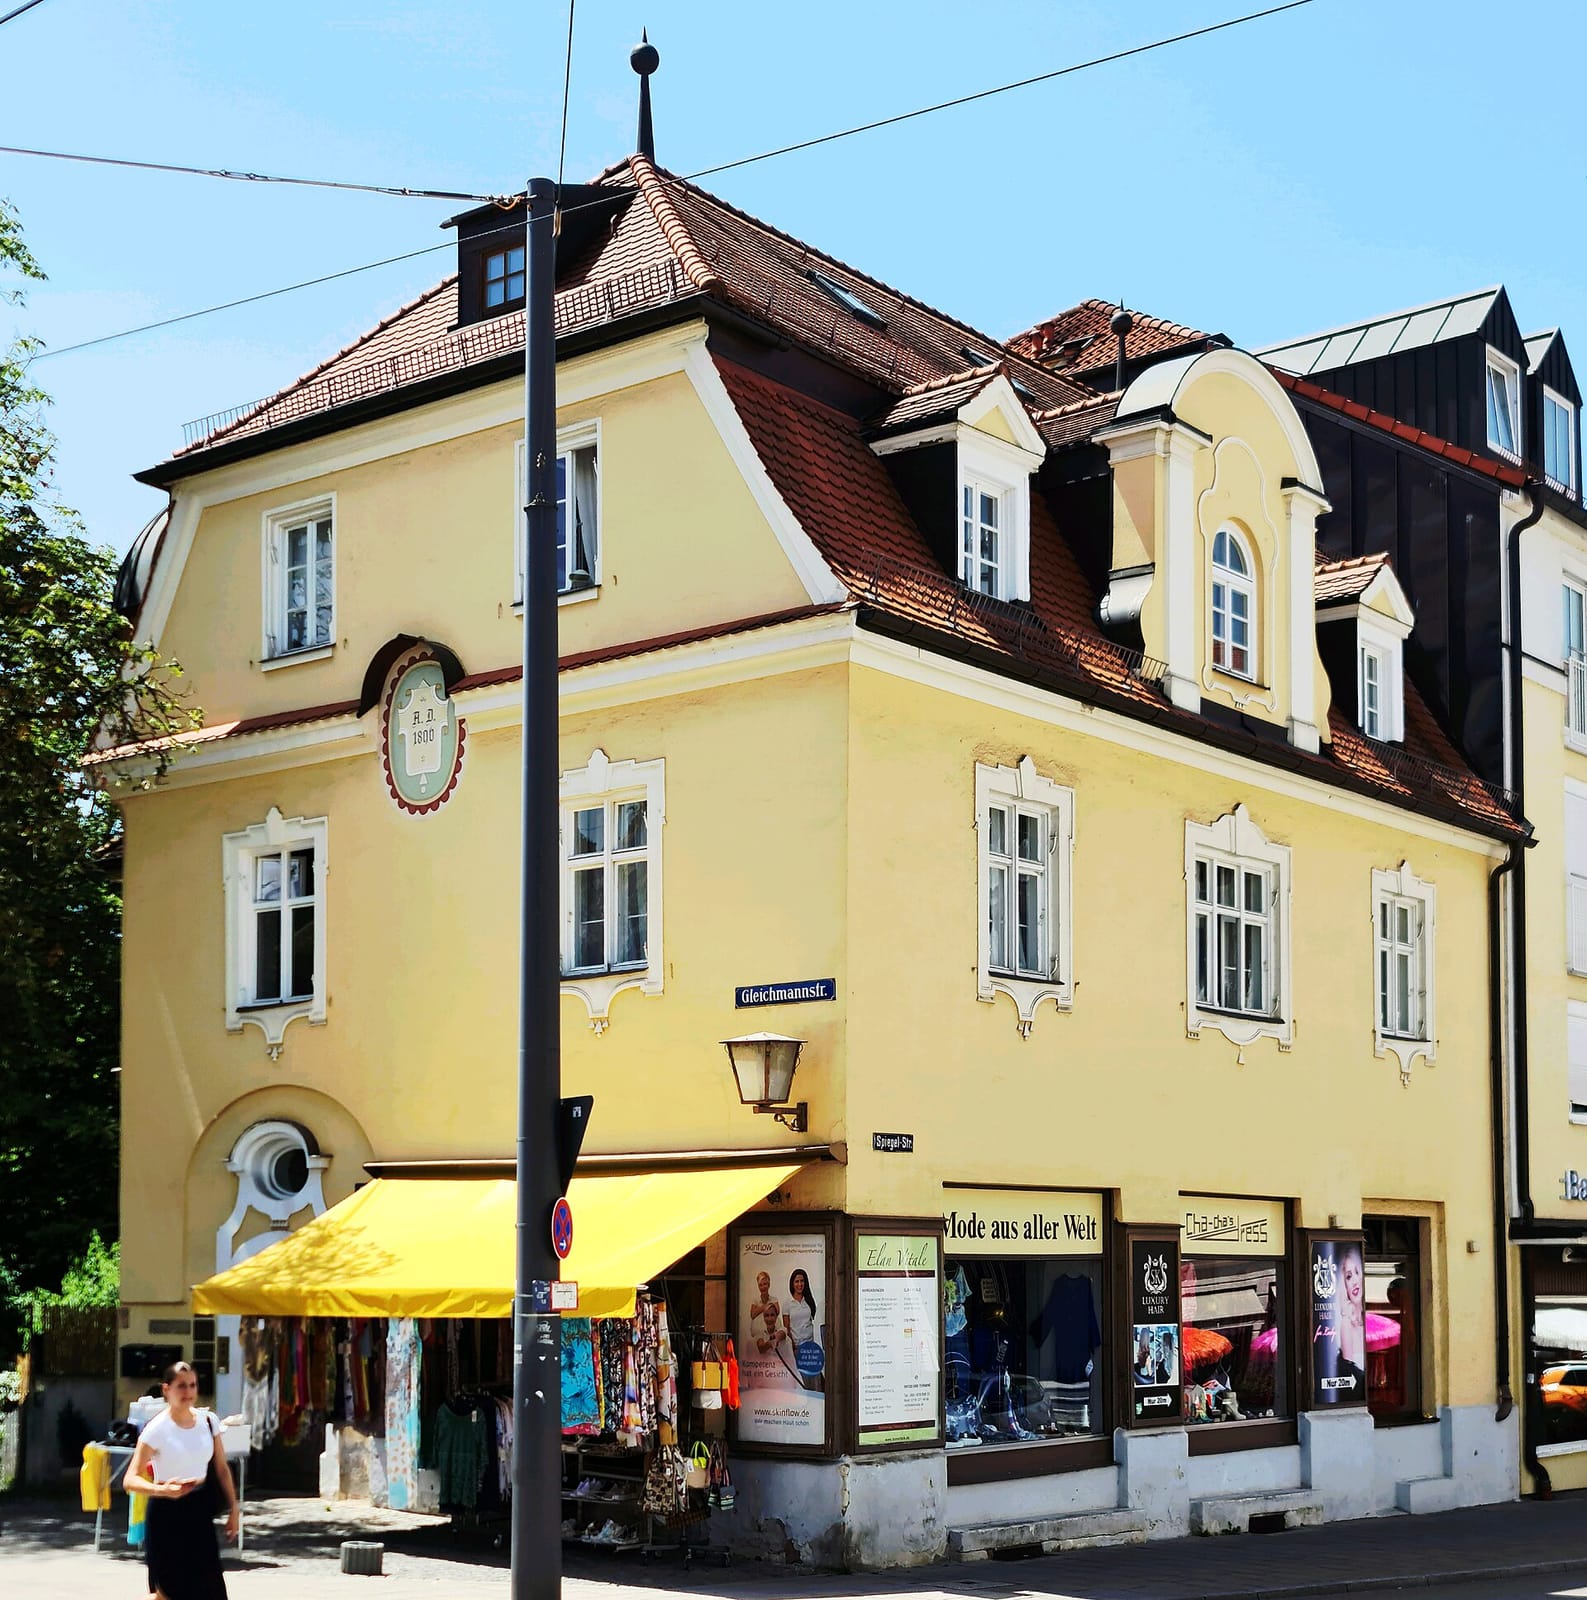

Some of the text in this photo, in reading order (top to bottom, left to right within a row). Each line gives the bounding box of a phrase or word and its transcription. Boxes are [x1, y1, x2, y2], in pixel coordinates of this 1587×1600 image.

[741, 983, 828, 1003] Gleichmannstr.
[876, 1135, 913, 1151] Spiegel-Str.
[943, 1212, 1098, 1241] Mode aus aller Welt
[745, 1242, 773, 1252] skinflow
[867, 1242, 892, 1267] Elan
[1150, 1269, 1161, 1286] SK
[1319, 1270, 1331, 1289] SK
[1142, 1295, 1170, 1306] LUXURY
[1147, 1305, 1166, 1315] HAIR
[765, 1370, 788, 1378] Gesicht
[754, 1408, 810, 1418] www.skinflow.de
